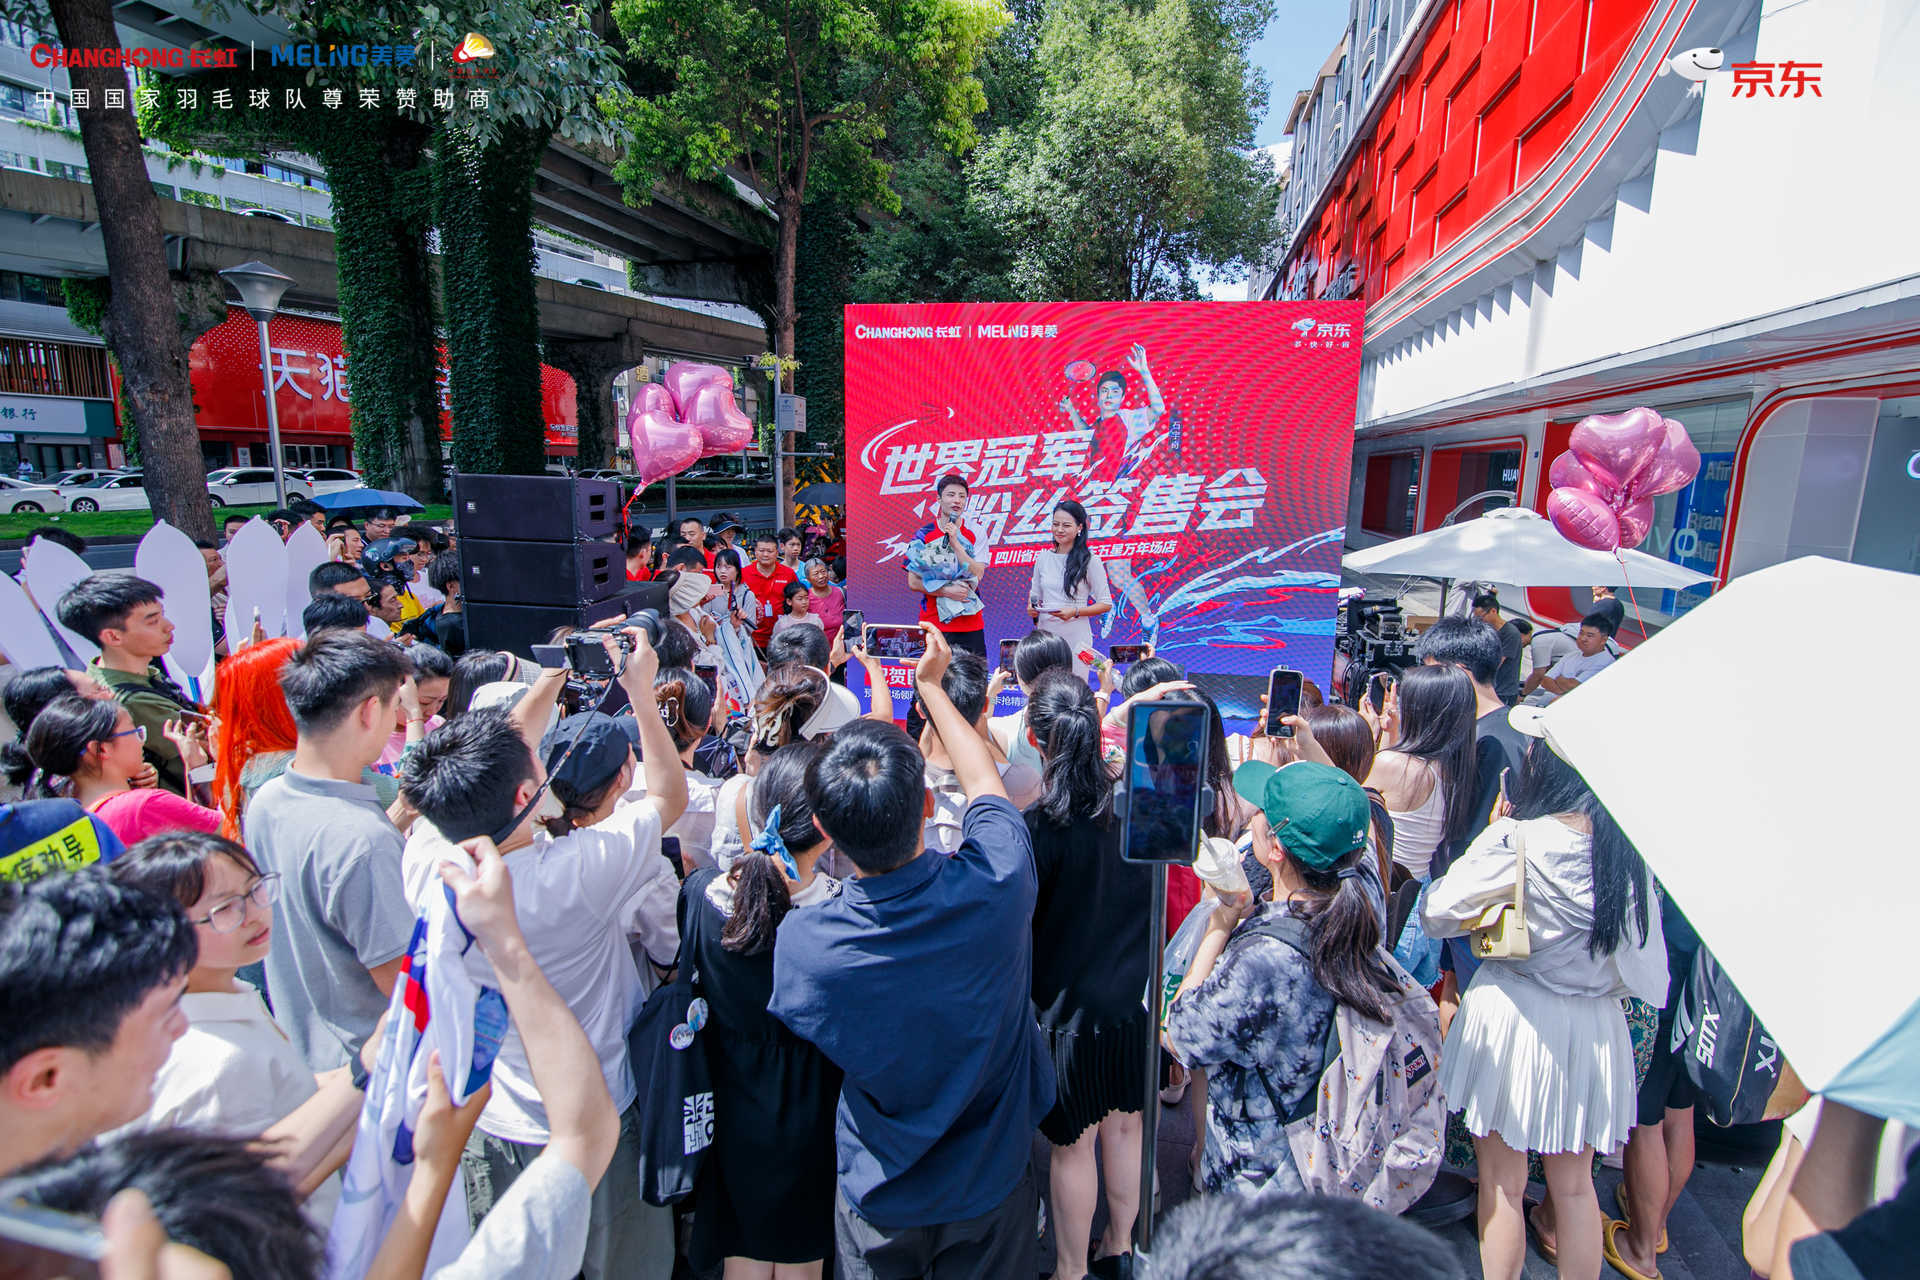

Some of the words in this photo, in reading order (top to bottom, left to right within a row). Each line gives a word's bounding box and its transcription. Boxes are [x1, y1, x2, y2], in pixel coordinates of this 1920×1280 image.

[855, 324, 934, 339] CHANGHONG
[935, 326, 962, 339] 长虹
[1030, 325, 1058, 339] 美菱
[1316, 323, 1352, 338] 京东
[0, 406, 37, 421] 银行
[879, 429, 1095, 497] 世界冠军
[959, 467, 1269, 545] 粉丝签售会
[1645, 525, 1699, 558] ivo
